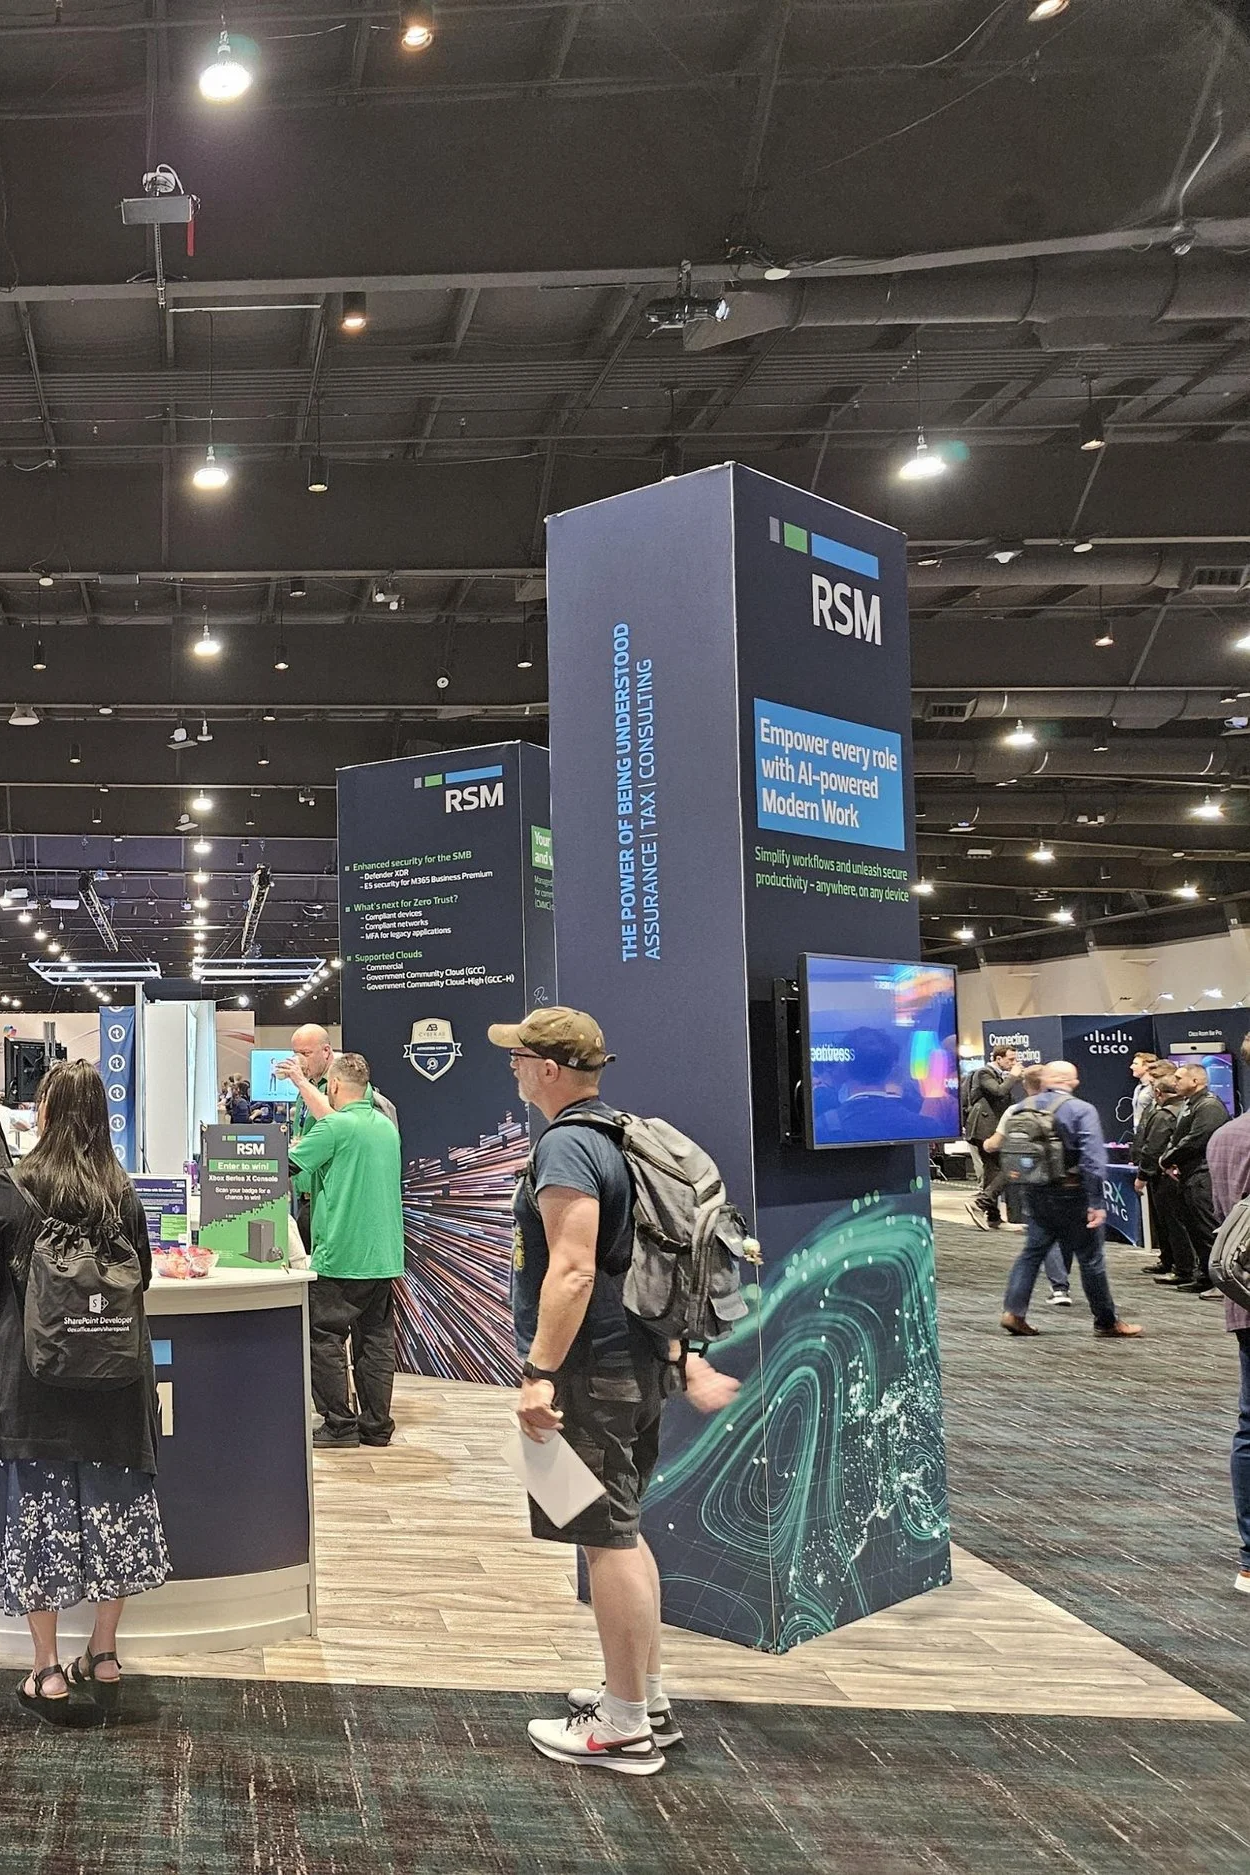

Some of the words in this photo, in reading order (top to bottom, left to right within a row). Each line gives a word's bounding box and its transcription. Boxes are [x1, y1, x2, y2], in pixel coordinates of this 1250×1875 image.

[812, 573, 882, 646] RSM
[613, 623, 632, 755] UNDERSTOOD
[637, 658, 655, 779] CONSULTING
[760, 718, 829, 757] Empower
[831, 739, 871, 771] every
[872, 747, 897, 771] role
[616, 757, 633, 815] BEING
[761, 756, 795, 783] with
[798, 761, 879, 799] AI-powered
[445, 783, 504, 813] RSM
[762, 787, 819, 821] Modern
[821, 799, 859, 829] Work
[640, 791, 656, 829] TAX
[534, 831, 551, 847] Your
[618, 819, 634, 845] OF
[353, 861, 390, 872] Enhanced
[391, 857, 423, 868] security
[424, 855, 436, 864] for
[437, 853, 451, 863] the
[452, 850, 472, 861] SMB
[534, 851, 548, 865] and
[755, 846, 791, 868] Simplify
[791, 853, 835, 871] workflows
[836, 860, 851, 873] and
[852, 861, 882, 878] unleash
[882, 867, 908, 881] secure
[364, 871, 393, 880] Defender
[394, 869, 409, 878] XDR
[373, 880, 400, 890] security
[400, 878, 410, 887] for
[410, 876, 431, 885] M365
[431, 873, 461, 883] Business
[461, 870, 493, 880] Premium
[619, 848, 636, 920] POWER
[755, 872, 808, 894] productivity
[816, 880, 858, 898] anywhere,
[858, 887, 869, 898] on
[870, 888, 884, 902] any
[885, 885, 909, 903] device
[354, 902, 381, 912] What's
[382, 901, 400, 909] next
[400, 899, 412, 908] for
[413, 898, 432, 907] Zero
[434, 895, 459, 905] Trust?
[642, 842, 661, 960] ASSURANCE
[365, 912, 396, 922] Compliant
[397, 909, 423, 918] devices
[365, 921, 396, 931] Compliant
[397, 919, 429, 928] networks
[365, 932, 379, 940] MFA
[380, 931, 390, 939] for
[390, 930, 411, 939] legacy
[412, 927, 452, 937] applications
[622, 924, 638, 962] THE
[355, 952, 395, 963] Supported
[396, 950, 423, 959] Clouds
[366, 962, 404, 971] Commercial
[366, 972, 405, 982] Government
[406, 969, 444, 980] Community
[445, 967, 465, 976] Cloud
[465, 966, 486, 976] (GCC)
[366, 982, 406, 991] Government
[406, 979, 444, 989] Community
[445, 976, 484, 987] Cloud-High
[485, 974, 515, 985] (GCC-H)
[989, 1032, 1029, 1047] Connecting
[237, 1143, 265, 1155] RSM
[218, 1162, 240, 1170] Enter
[241, 1162, 250, 1170] to
[252, 1162, 269, 1170] win!
[64, 1316, 99, 1325] SharePoint
[100, 1316, 133, 1325] Developer
